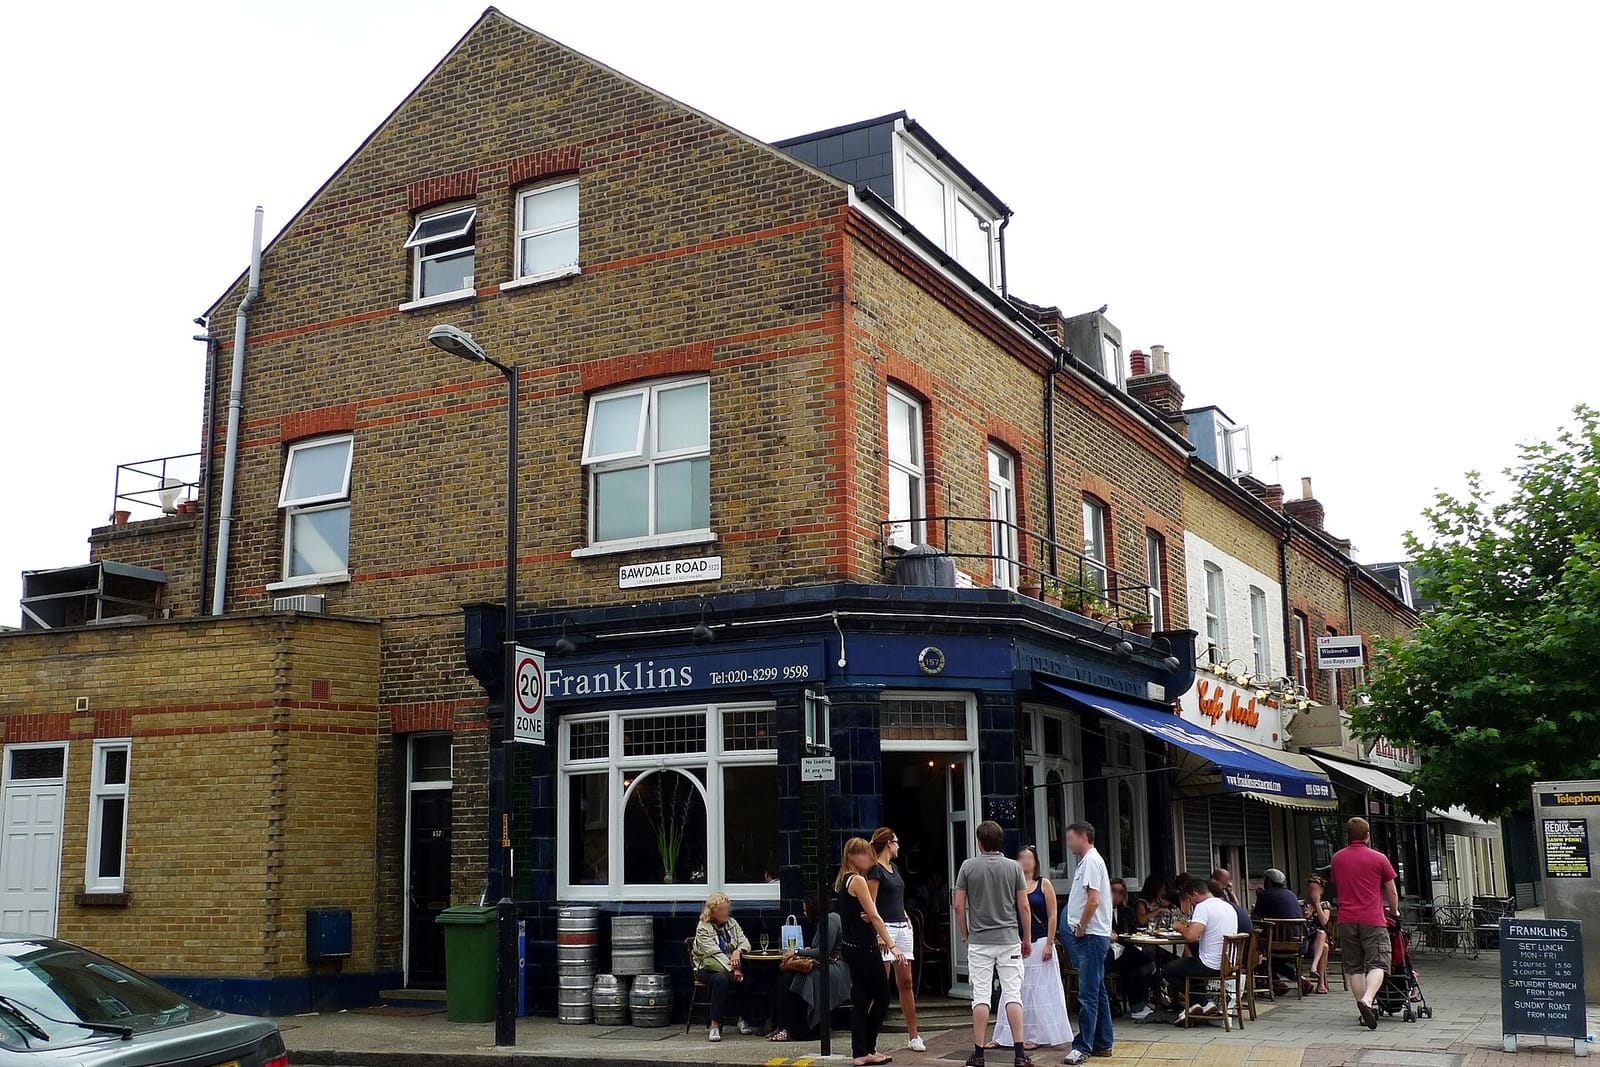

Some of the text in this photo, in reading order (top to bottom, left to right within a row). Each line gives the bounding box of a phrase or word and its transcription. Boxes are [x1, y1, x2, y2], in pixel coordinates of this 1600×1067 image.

[621, 564, 670, 580] BAWDALE
[675, 560, 707, 574] ROAD
[545, 661, 809, 697] Franklins Tel:020-8299 9598
[520, 674, 539, 698] 20
[517, 716, 541, 733] ZONE
[1544, 823, 1569, 833] REDUX
[1509, 925, 1568, 937] FRANKLINS
[1518, 942, 1564, 952] SET LUNCH
[1508, 979, 1577, 990] SATURDAY BRUNCH
[1514, 1000, 1572, 1011] SUNDAY ROAST
[1527, 1011, 1567, 1020] FROM NOON
